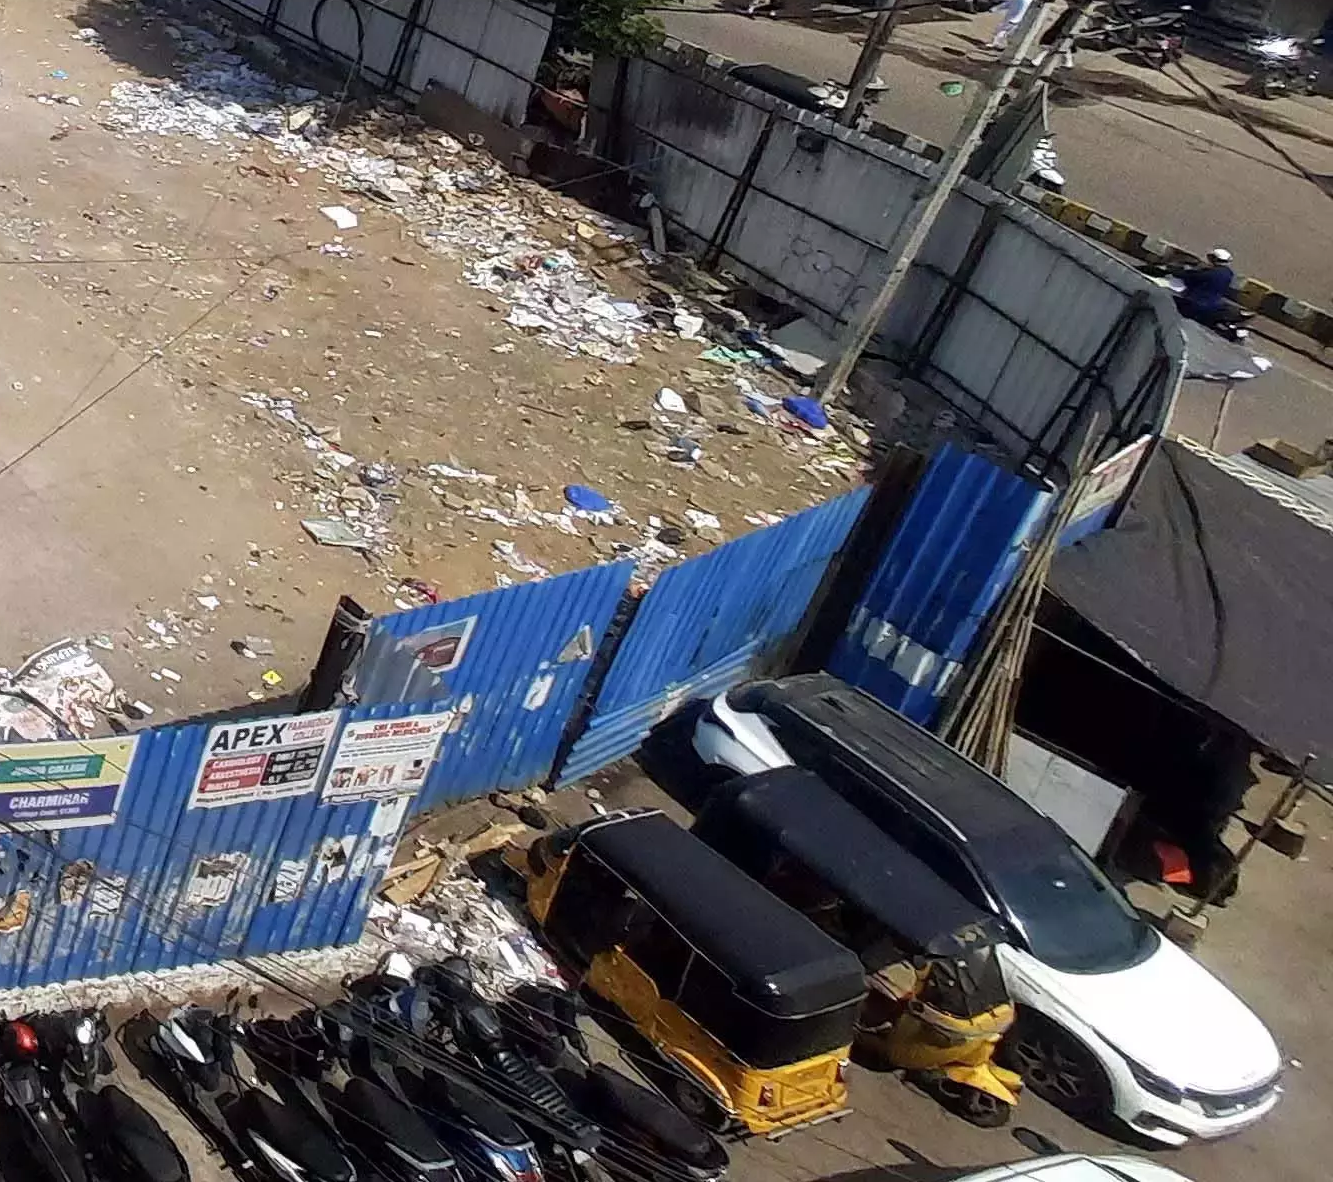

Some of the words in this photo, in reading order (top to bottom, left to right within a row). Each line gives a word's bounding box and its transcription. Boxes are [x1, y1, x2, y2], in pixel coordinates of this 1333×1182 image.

[210, 722, 288, 752] APEX
[47, 764, 88, 774] COLLEGE
[9, 793, 90, 810] CHARMINAR
